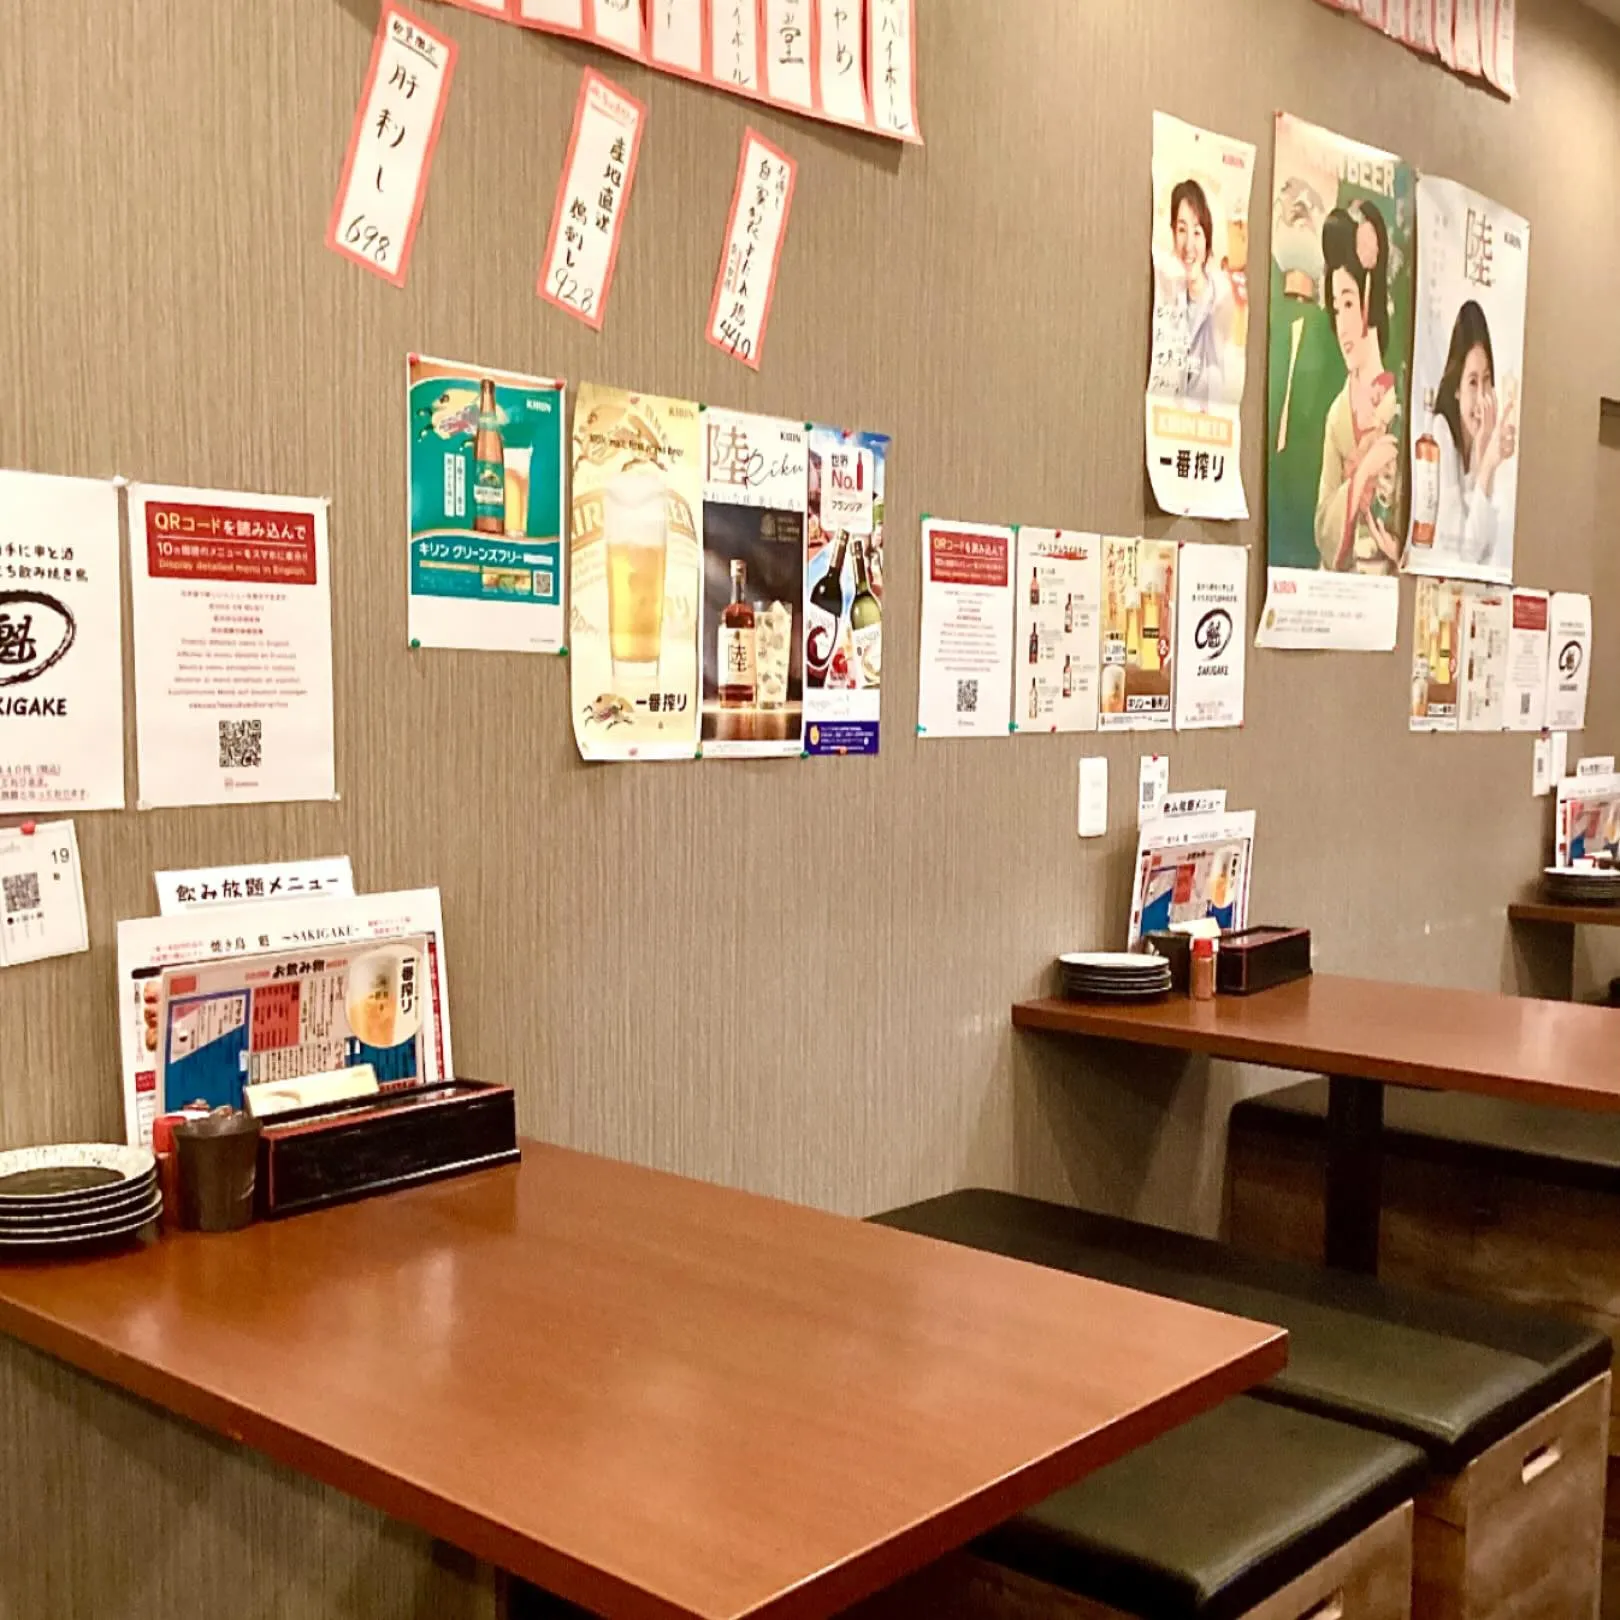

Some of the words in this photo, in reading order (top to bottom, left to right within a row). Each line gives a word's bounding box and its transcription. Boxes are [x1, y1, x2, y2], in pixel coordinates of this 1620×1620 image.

[345, 213, 391, 262] 698
[555, 267, 595, 314] 928
[526, 398, 553, 413] KIRIN
[1158, 449, 1225, 483] 一番搾り
[154, 511, 307, 541] QRコードを読み込んで
[418, 540, 451, 558] キリン
[636, 692, 688, 713] 一番搾り
[51, 847, 70, 865] 19
[176, 877, 339, 902] 飲み放題メニュー
